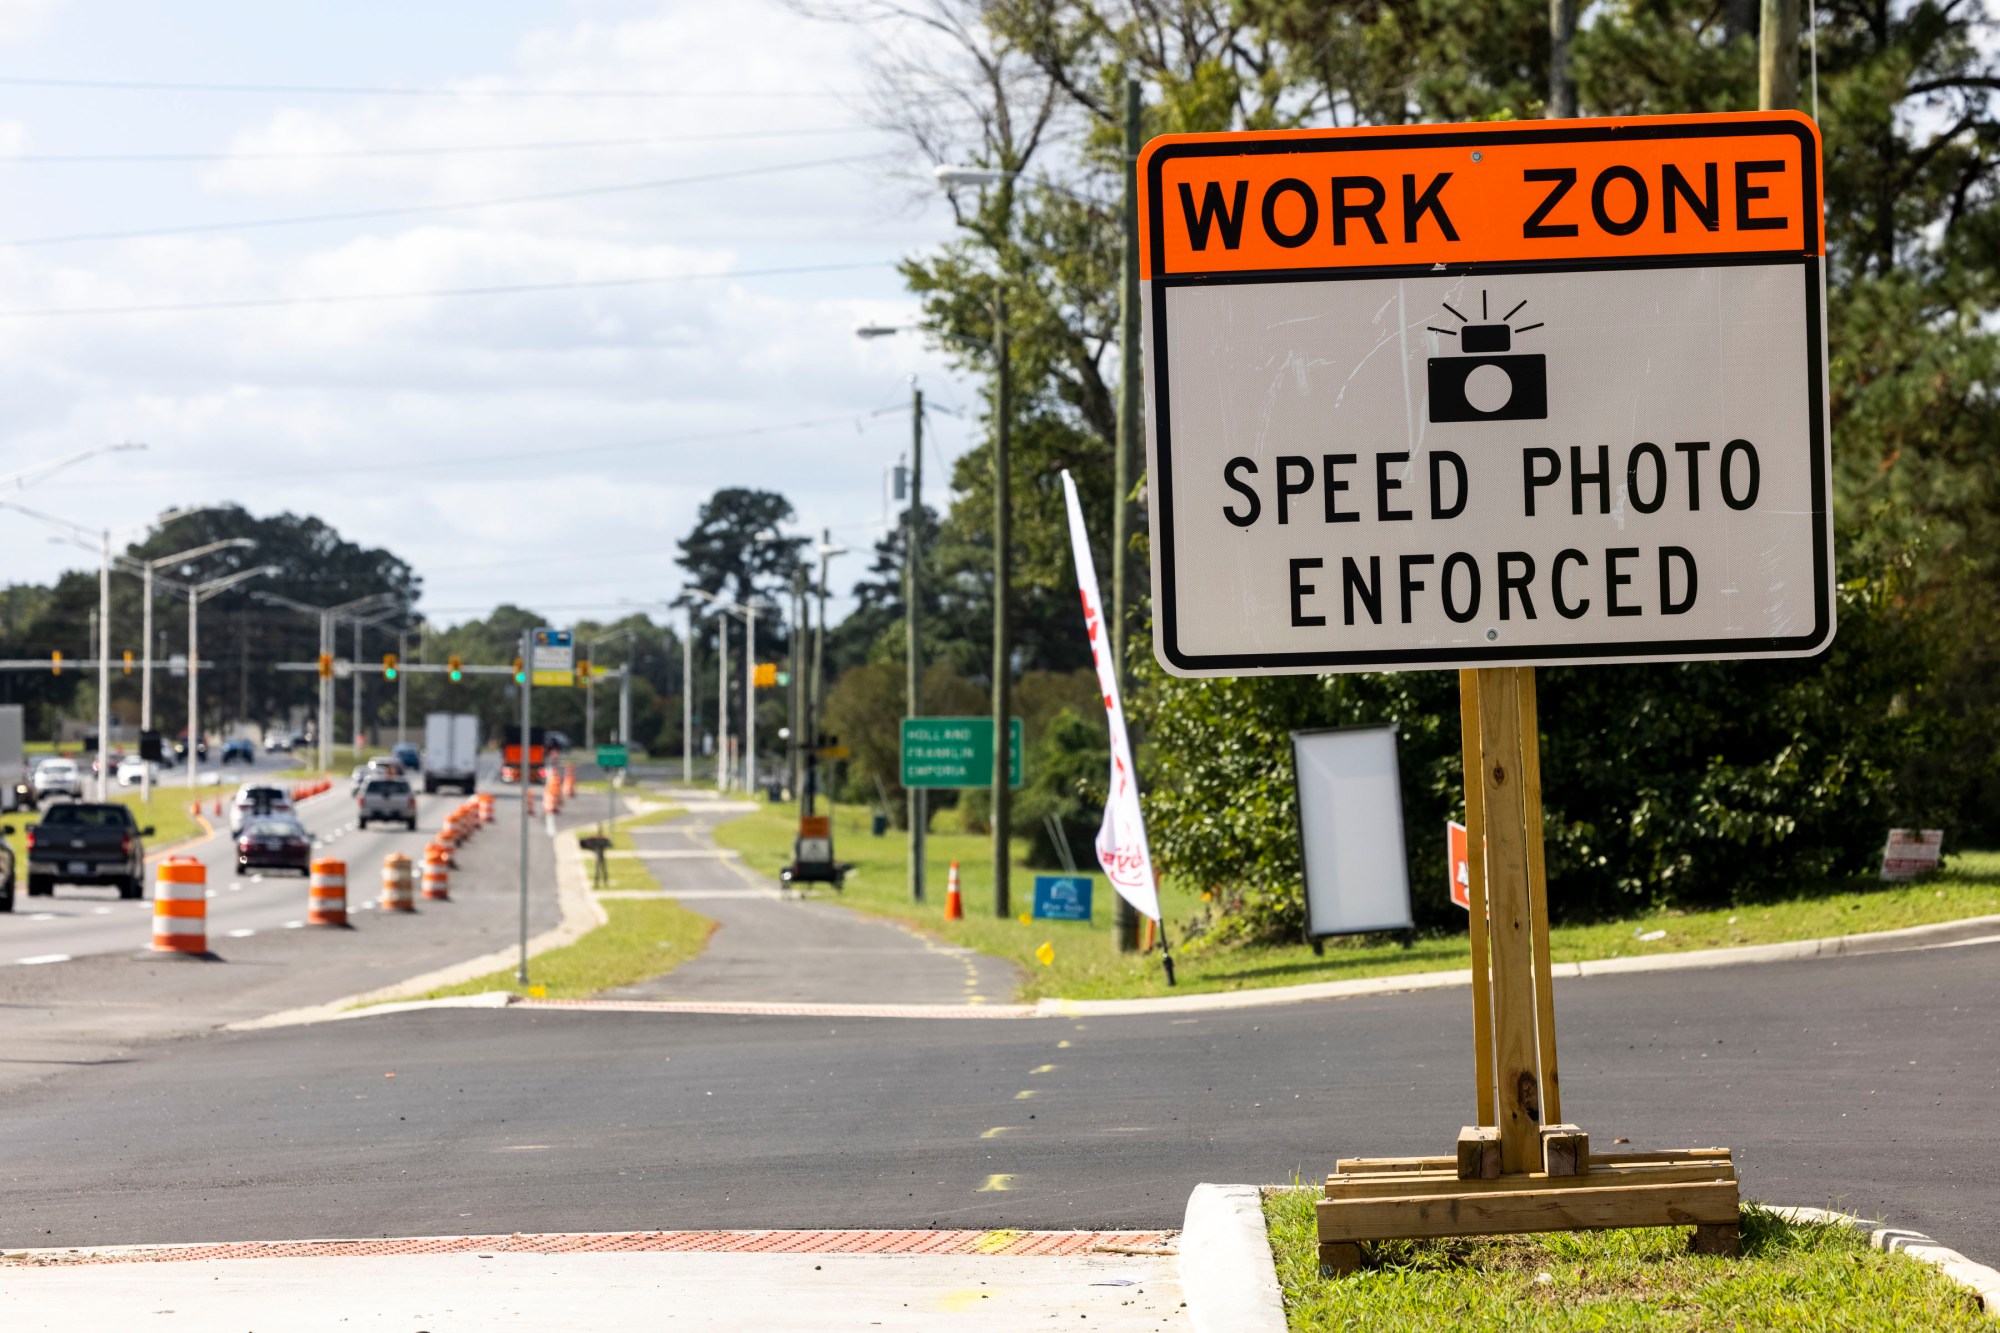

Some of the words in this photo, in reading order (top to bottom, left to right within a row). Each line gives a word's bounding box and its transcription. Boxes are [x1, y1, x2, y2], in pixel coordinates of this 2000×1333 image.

[1178, 173, 1459, 250] WORK
[1524, 160, 1787, 238] ZONE
[1223, 450, 1468, 527] SPEED
[1523, 438, 1760, 516] PHOTO
[1290, 546, 1697, 627] ENFORCED
[907, 728, 972, 741] HOLLAND
[907, 747, 975, 759] FRANKLIN
[907, 765, 967, 777] EMPORIA
